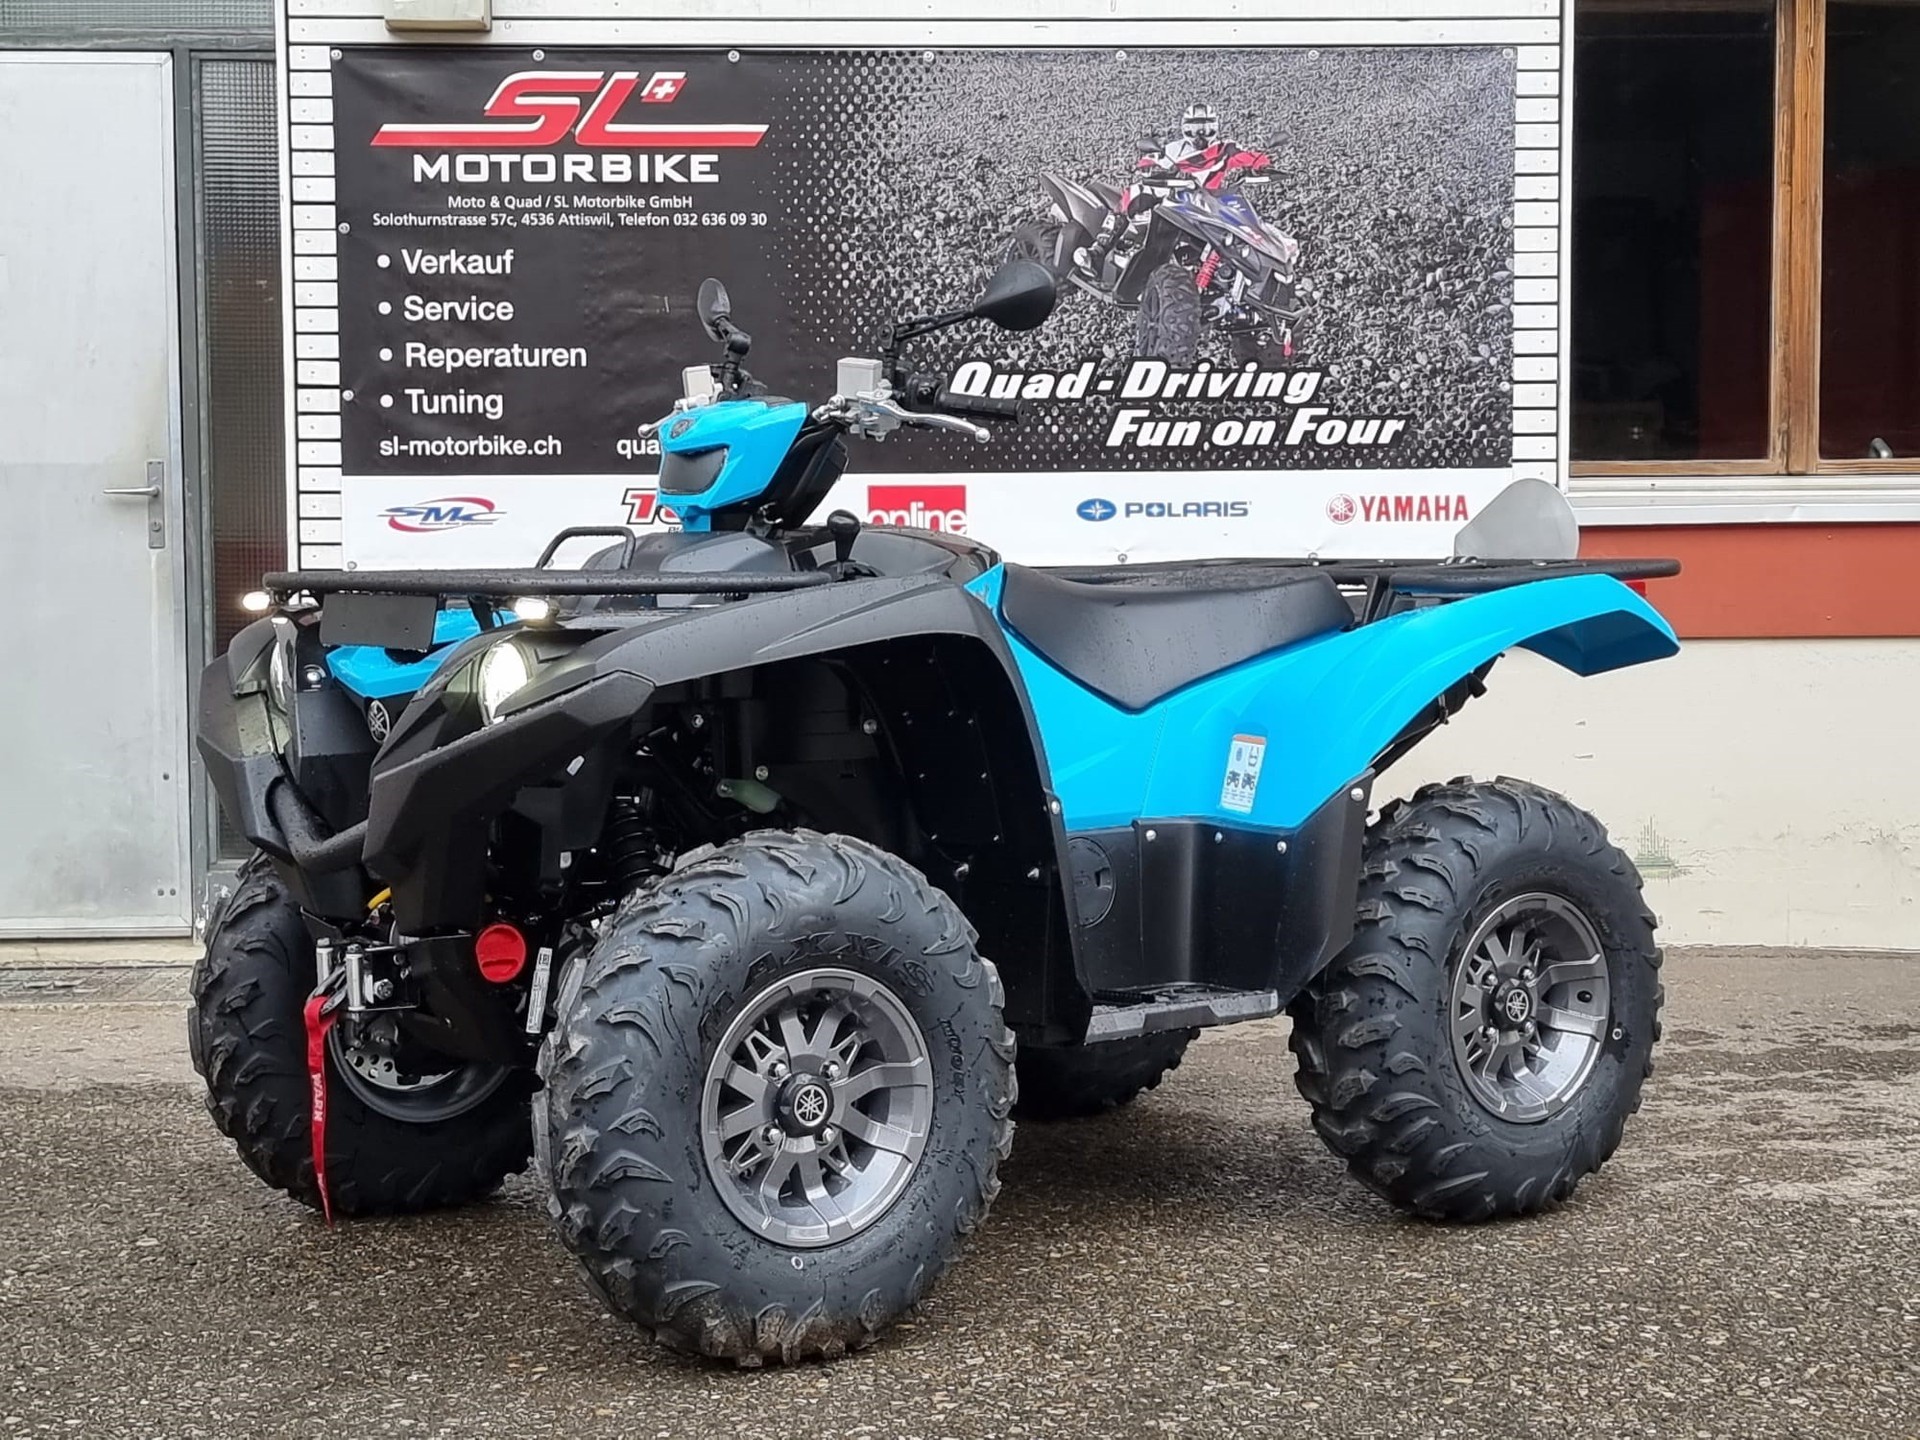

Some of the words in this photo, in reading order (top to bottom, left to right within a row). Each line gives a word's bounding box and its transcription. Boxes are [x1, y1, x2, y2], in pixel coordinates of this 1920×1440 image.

[413, 154, 719, 183] MOTORBIKE
[448, 196, 486, 208] Moto
[490, 196, 501, 208] &
[504, 195, 542, 209] Quad
[554, 196, 569, 208] SL
[573, 195, 646, 208] Motorbike
[650, 196, 693, 208] GmbH
[372, 213, 487, 226] Solothurnstrasse
[491, 213, 517, 227] 57c,
[521, 213, 555, 226] 4536
[558, 213, 614, 227] Attiswil,
[618, 213, 670, 226] Telefon
[673, 213, 698, 226] 032
[702, 213, 727, 226] 636
[730, 213, 747, 226] 09
[750, 213, 767, 226] 30
[401, 249, 514, 274] Verkauf
[404, 295, 514, 321] Service
[405, 342, 587, 373] Reperaturen
[949, 361, 1096, 400] Quad
[1121, 361, 1321, 403] Driving
[404, 388, 504, 419] Tuning
[1106, 410, 1201, 446] Fun
[1211, 420, 1278, 446] on
[1284, 408, 1406, 445] Four
[379, 435, 562, 456] sl-motorbike.ch
[616, 439, 661, 460] qua
[868, 501, 967, 535] online
[1125, 501, 1248, 518] POLARIS
[1360, 495, 1469, 522] YAMAHA
[311, 1073, 324, 1122] WARN
